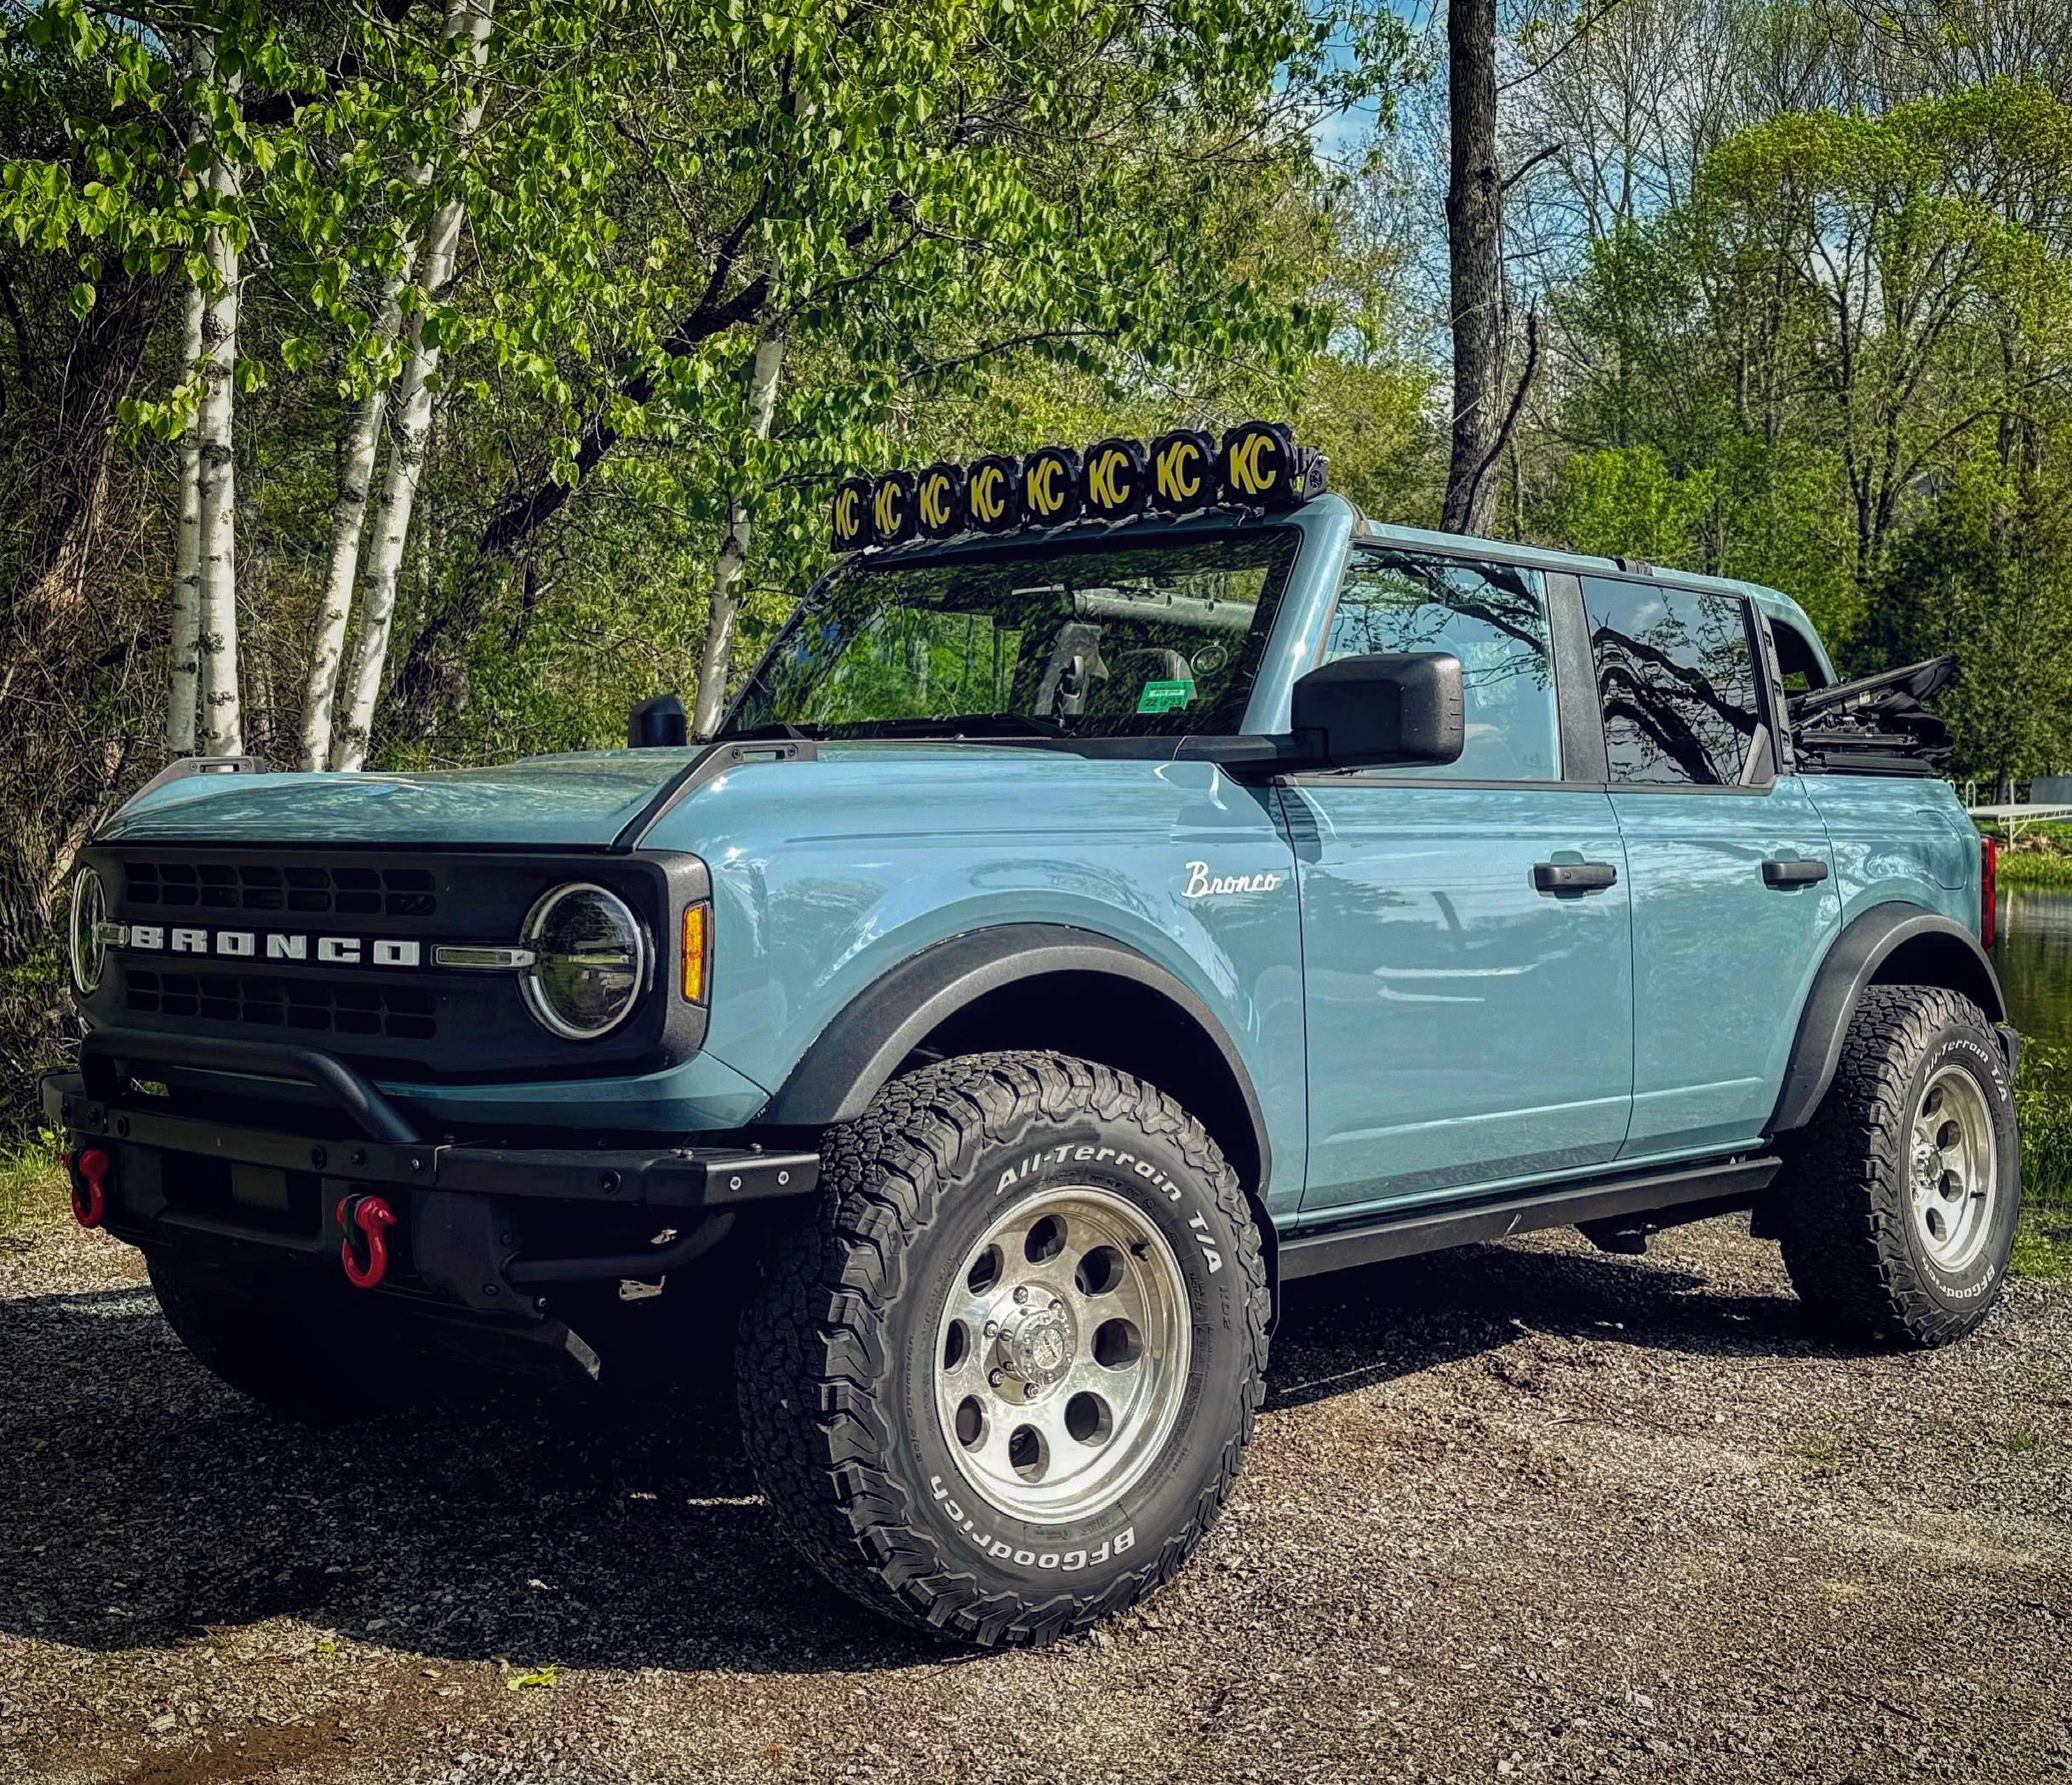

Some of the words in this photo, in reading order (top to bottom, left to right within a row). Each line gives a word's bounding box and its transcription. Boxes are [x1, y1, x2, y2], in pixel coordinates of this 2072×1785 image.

[1027, 456, 1065, 516] KC
[1089, 449, 1130, 509] KC
[1157, 441, 1200, 501] KC
[1227, 432, 1276, 495] KC
[835, 487, 859, 541] KC
[875, 480, 901, 535] KC
[920, 473, 950, 529] KC
[970, 466, 1005, 523] KC
[1181, 861, 1281, 898] Bronco
[130, 925, 421, 967] BRONCO
[994, 1143, 1182, 1203] All-Terrain
[1188, 1209, 1223, 1274] T/A
[1921, 1256, 1996, 1299] BFGoodrich
[930, 1475, 1136, 1571] BFGoodrich
